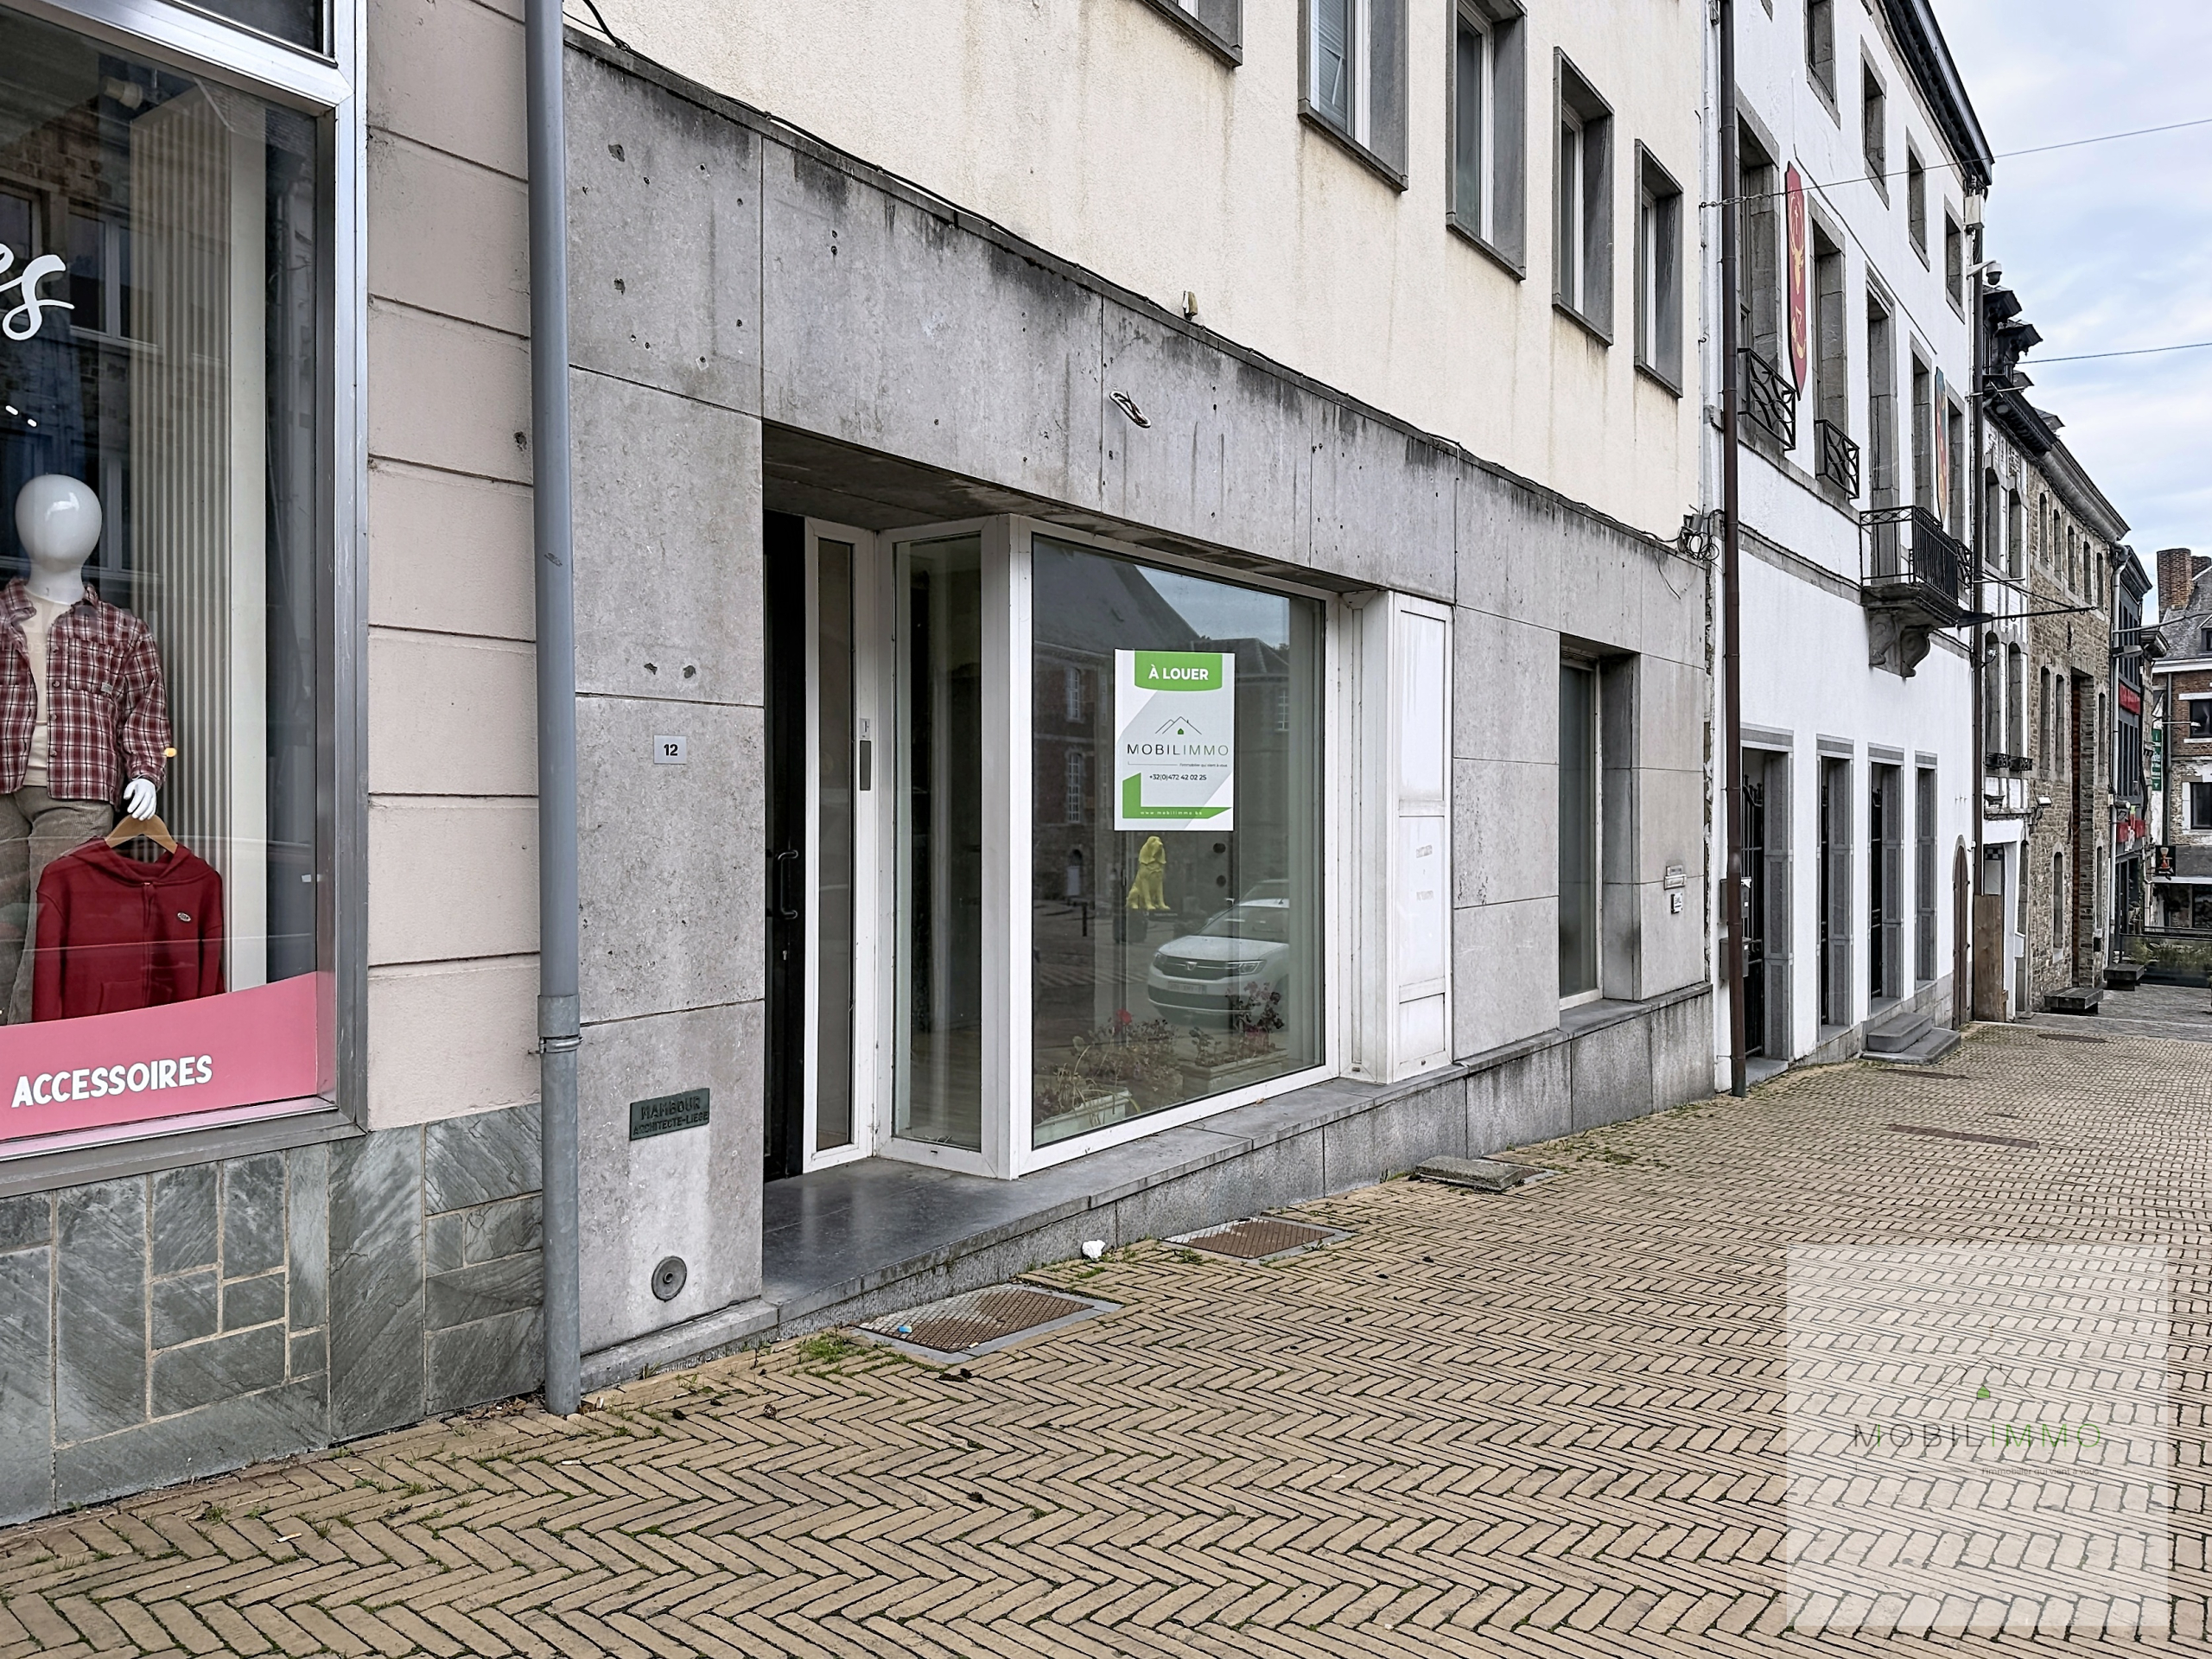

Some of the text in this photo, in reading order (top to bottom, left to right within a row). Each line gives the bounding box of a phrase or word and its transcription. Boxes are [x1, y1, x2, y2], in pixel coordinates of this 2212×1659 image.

[1148, 664, 1209, 681] À LOUER
[664, 743, 678, 756] 12
[1127, 743, 1229, 756] MOBILIMMO
[1149, 773, 1179, 782] +32(0)472
[11, 1054, 213, 1108] ACCESSOIRES
